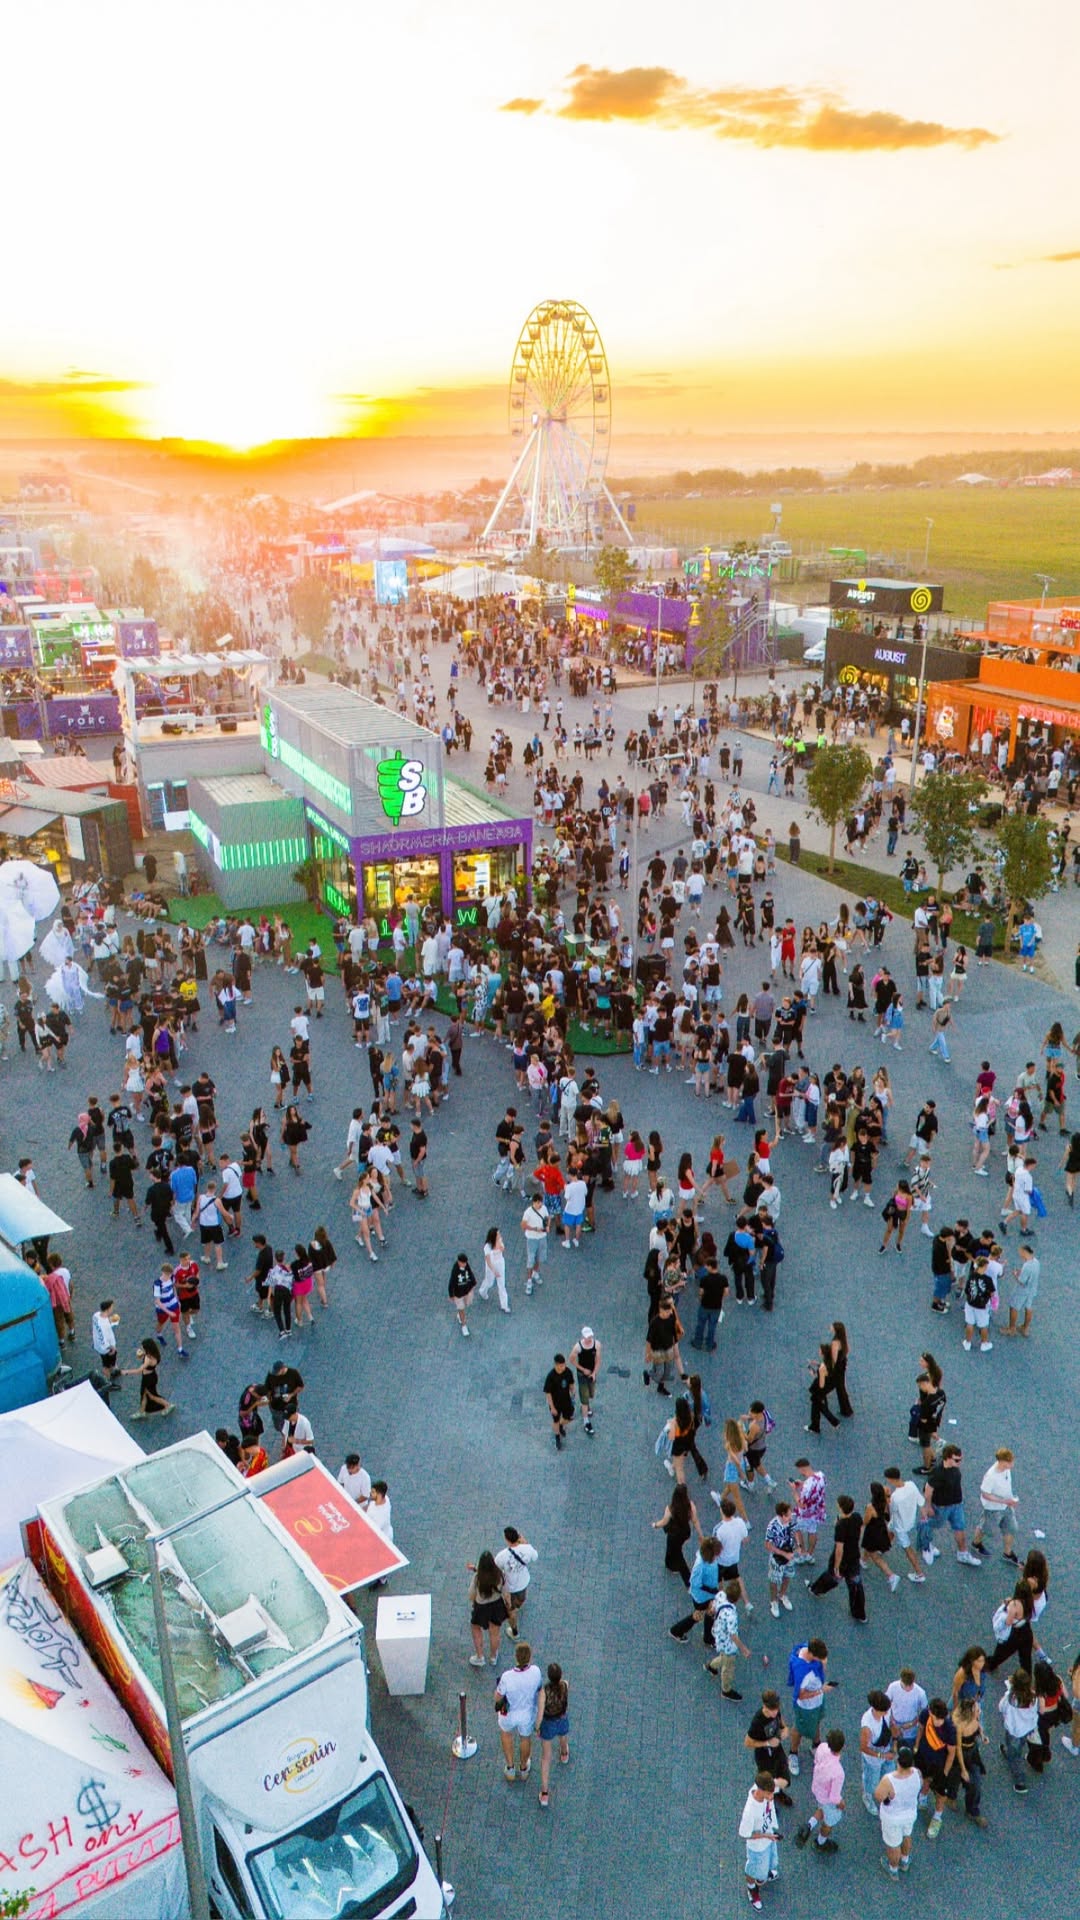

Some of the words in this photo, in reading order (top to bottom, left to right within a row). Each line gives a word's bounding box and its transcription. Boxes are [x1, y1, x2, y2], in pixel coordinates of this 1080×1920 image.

[874, 648, 907, 665] AUGUST
[68, 715, 106, 727] PORC
[294, 1740, 337, 1774] senin
